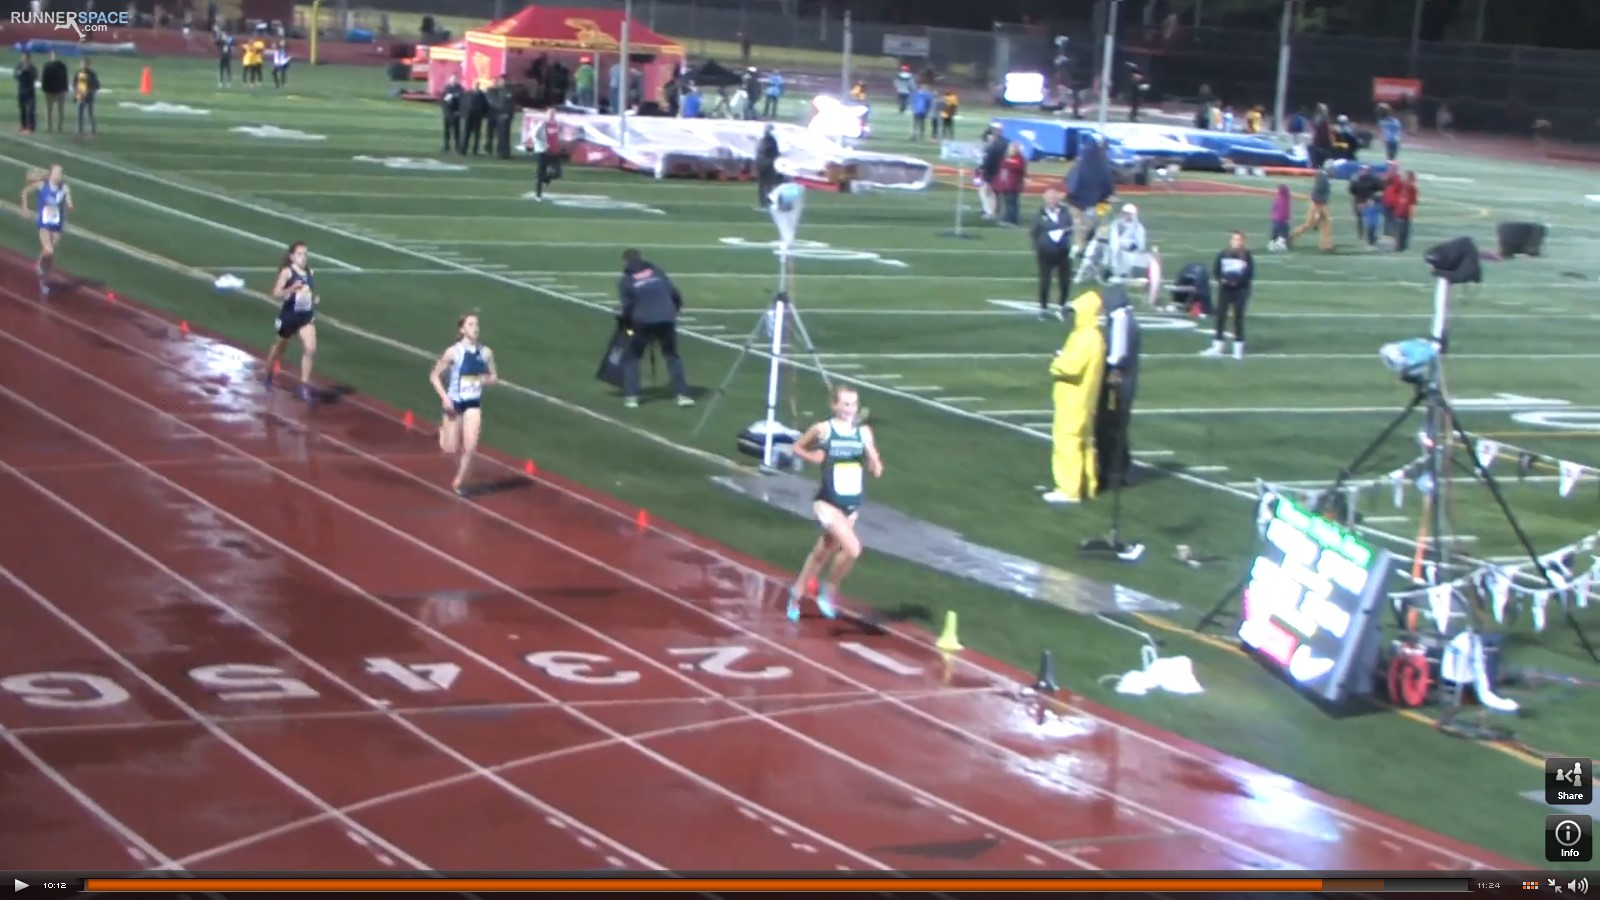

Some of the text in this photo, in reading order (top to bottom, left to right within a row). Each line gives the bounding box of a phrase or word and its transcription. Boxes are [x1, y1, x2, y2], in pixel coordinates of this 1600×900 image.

[363, 657, 462, 691] 4
[524, 651, 641, 684] 3
[666, 646, 793, 680] 2
[838, 641, 924, 676] 1
[0, 671, 131, 708] 6
[187, 663, 320, 701] 5
